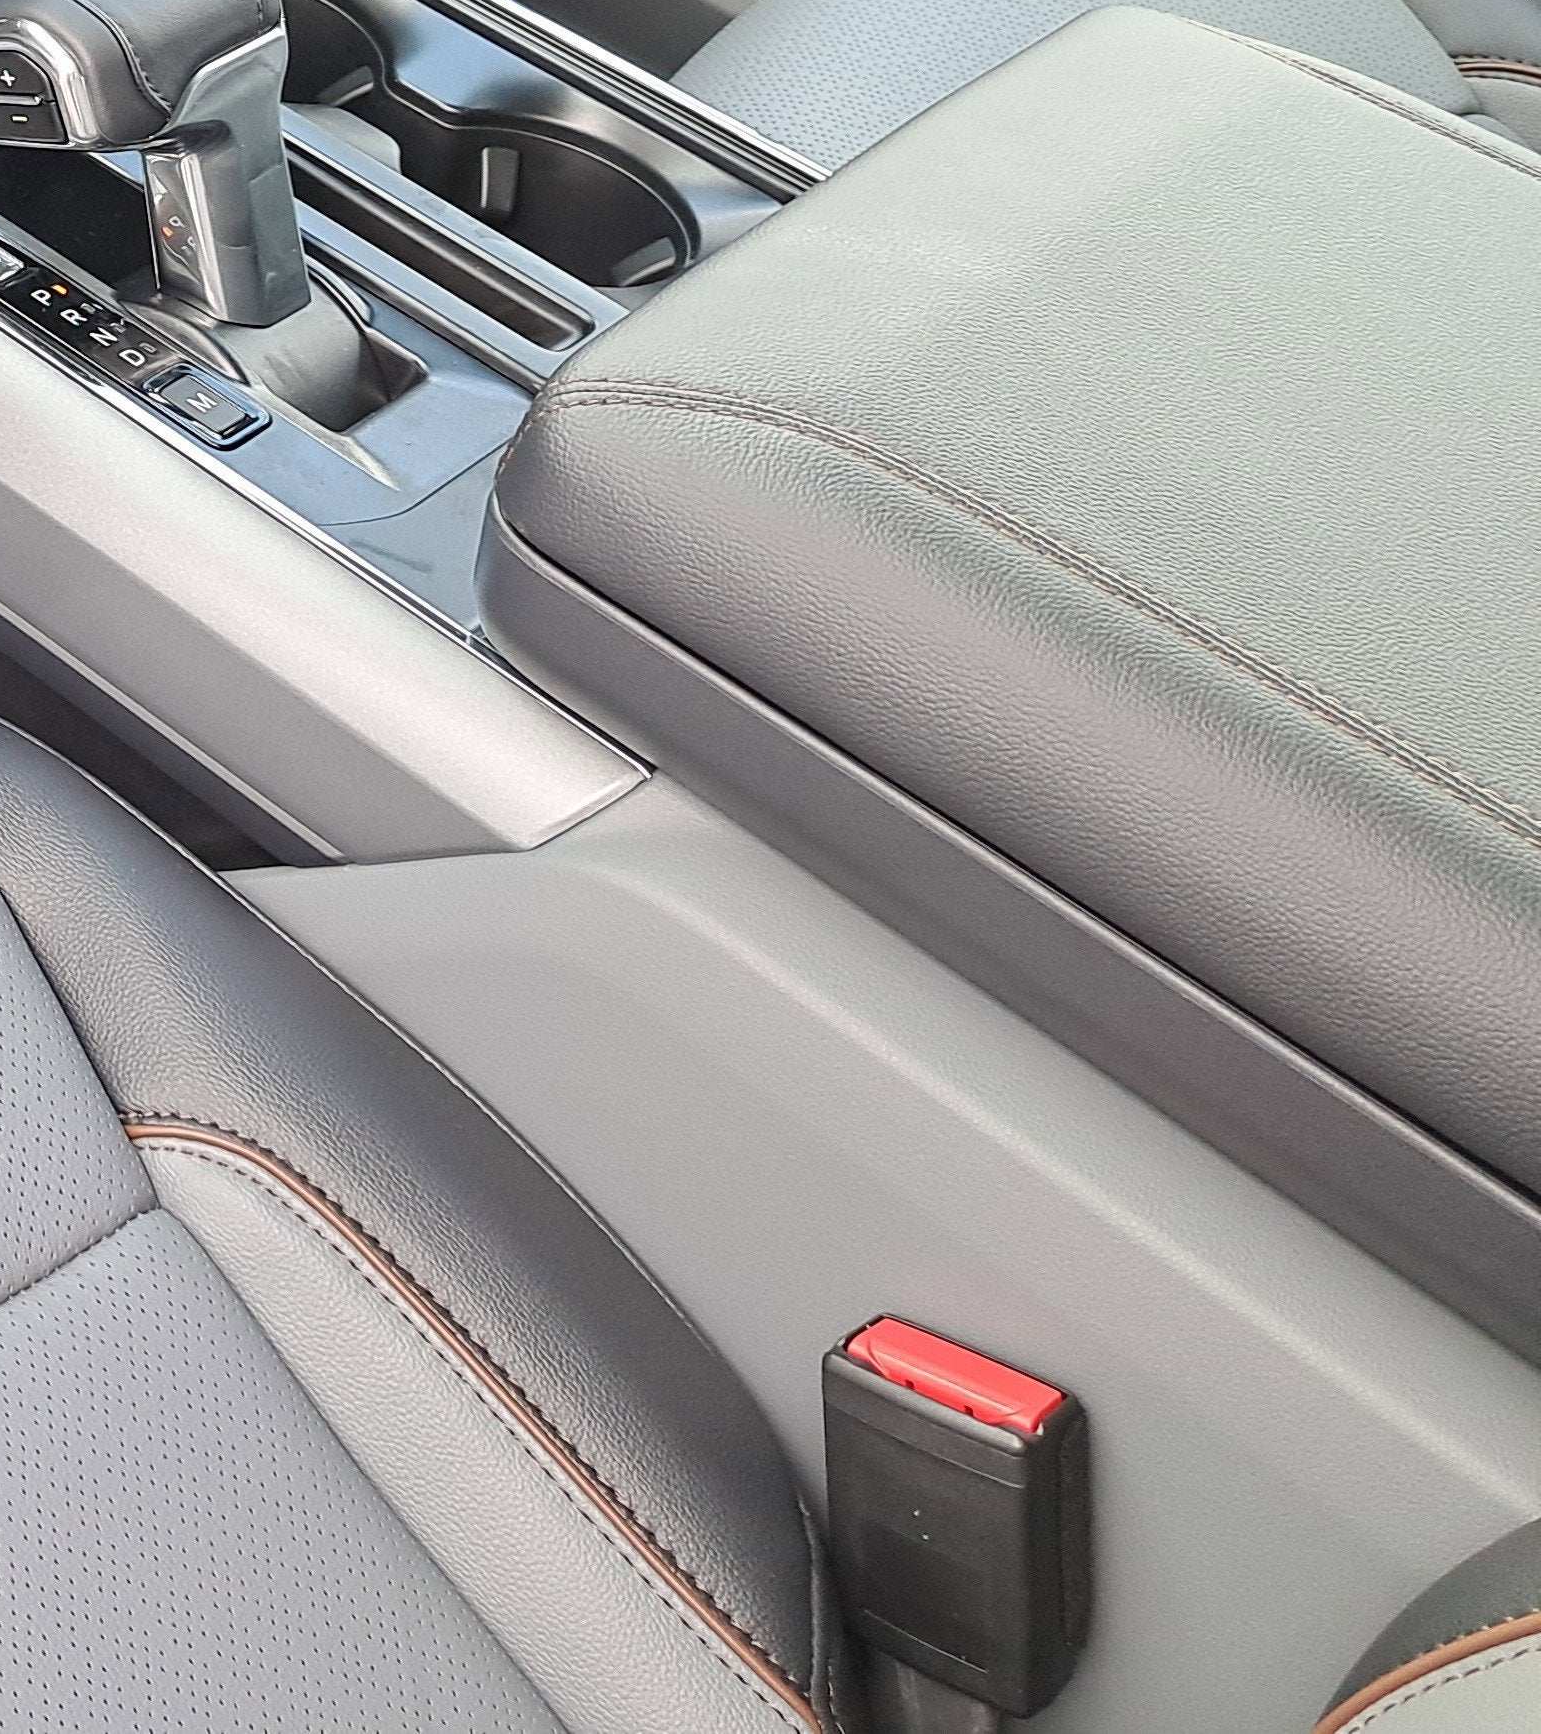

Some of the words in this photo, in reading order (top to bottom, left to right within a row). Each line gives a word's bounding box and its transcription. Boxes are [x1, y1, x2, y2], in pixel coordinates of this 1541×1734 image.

[31, 288, 52, 307] P
[59, 308, 88, 327] R
[89, 326, 119, 347] N
[118, 348, 146, 367] D
[186, 392, 218, 413] M
